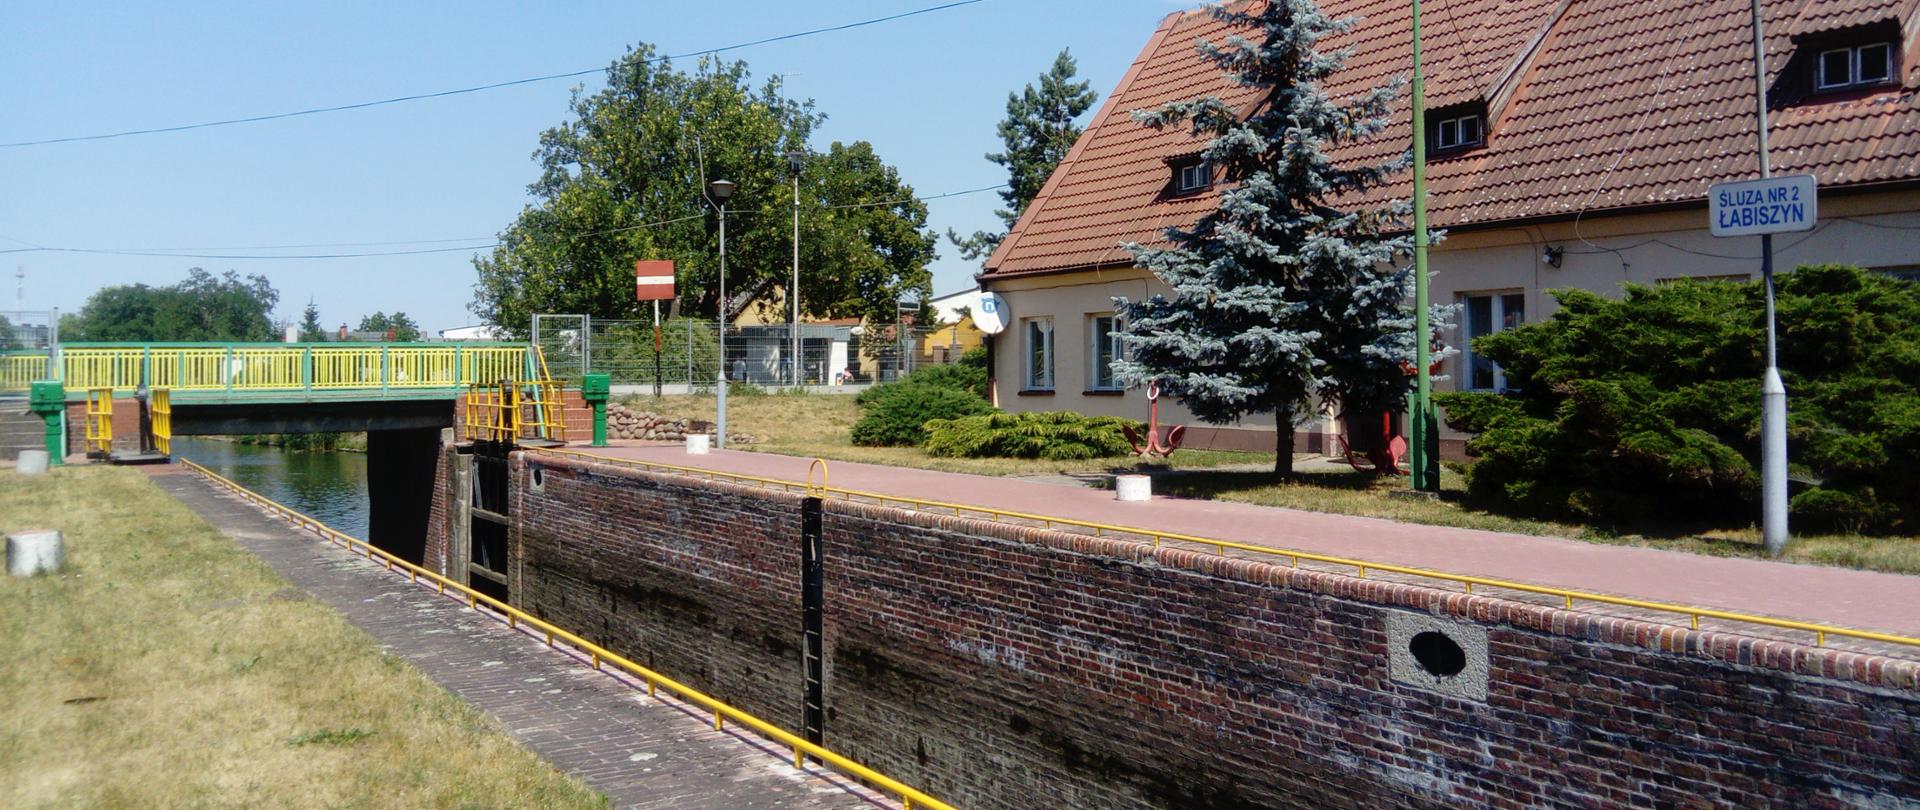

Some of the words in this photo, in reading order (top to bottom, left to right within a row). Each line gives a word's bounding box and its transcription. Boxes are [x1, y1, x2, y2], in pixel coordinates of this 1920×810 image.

[1719, 189, 1764, 208] ŚLUZA
[1768, 187, 1788, 203] NR
[1792, 186, 1799, 201] 2
[1719, 203, 1804, 228] ŁABISZYN
